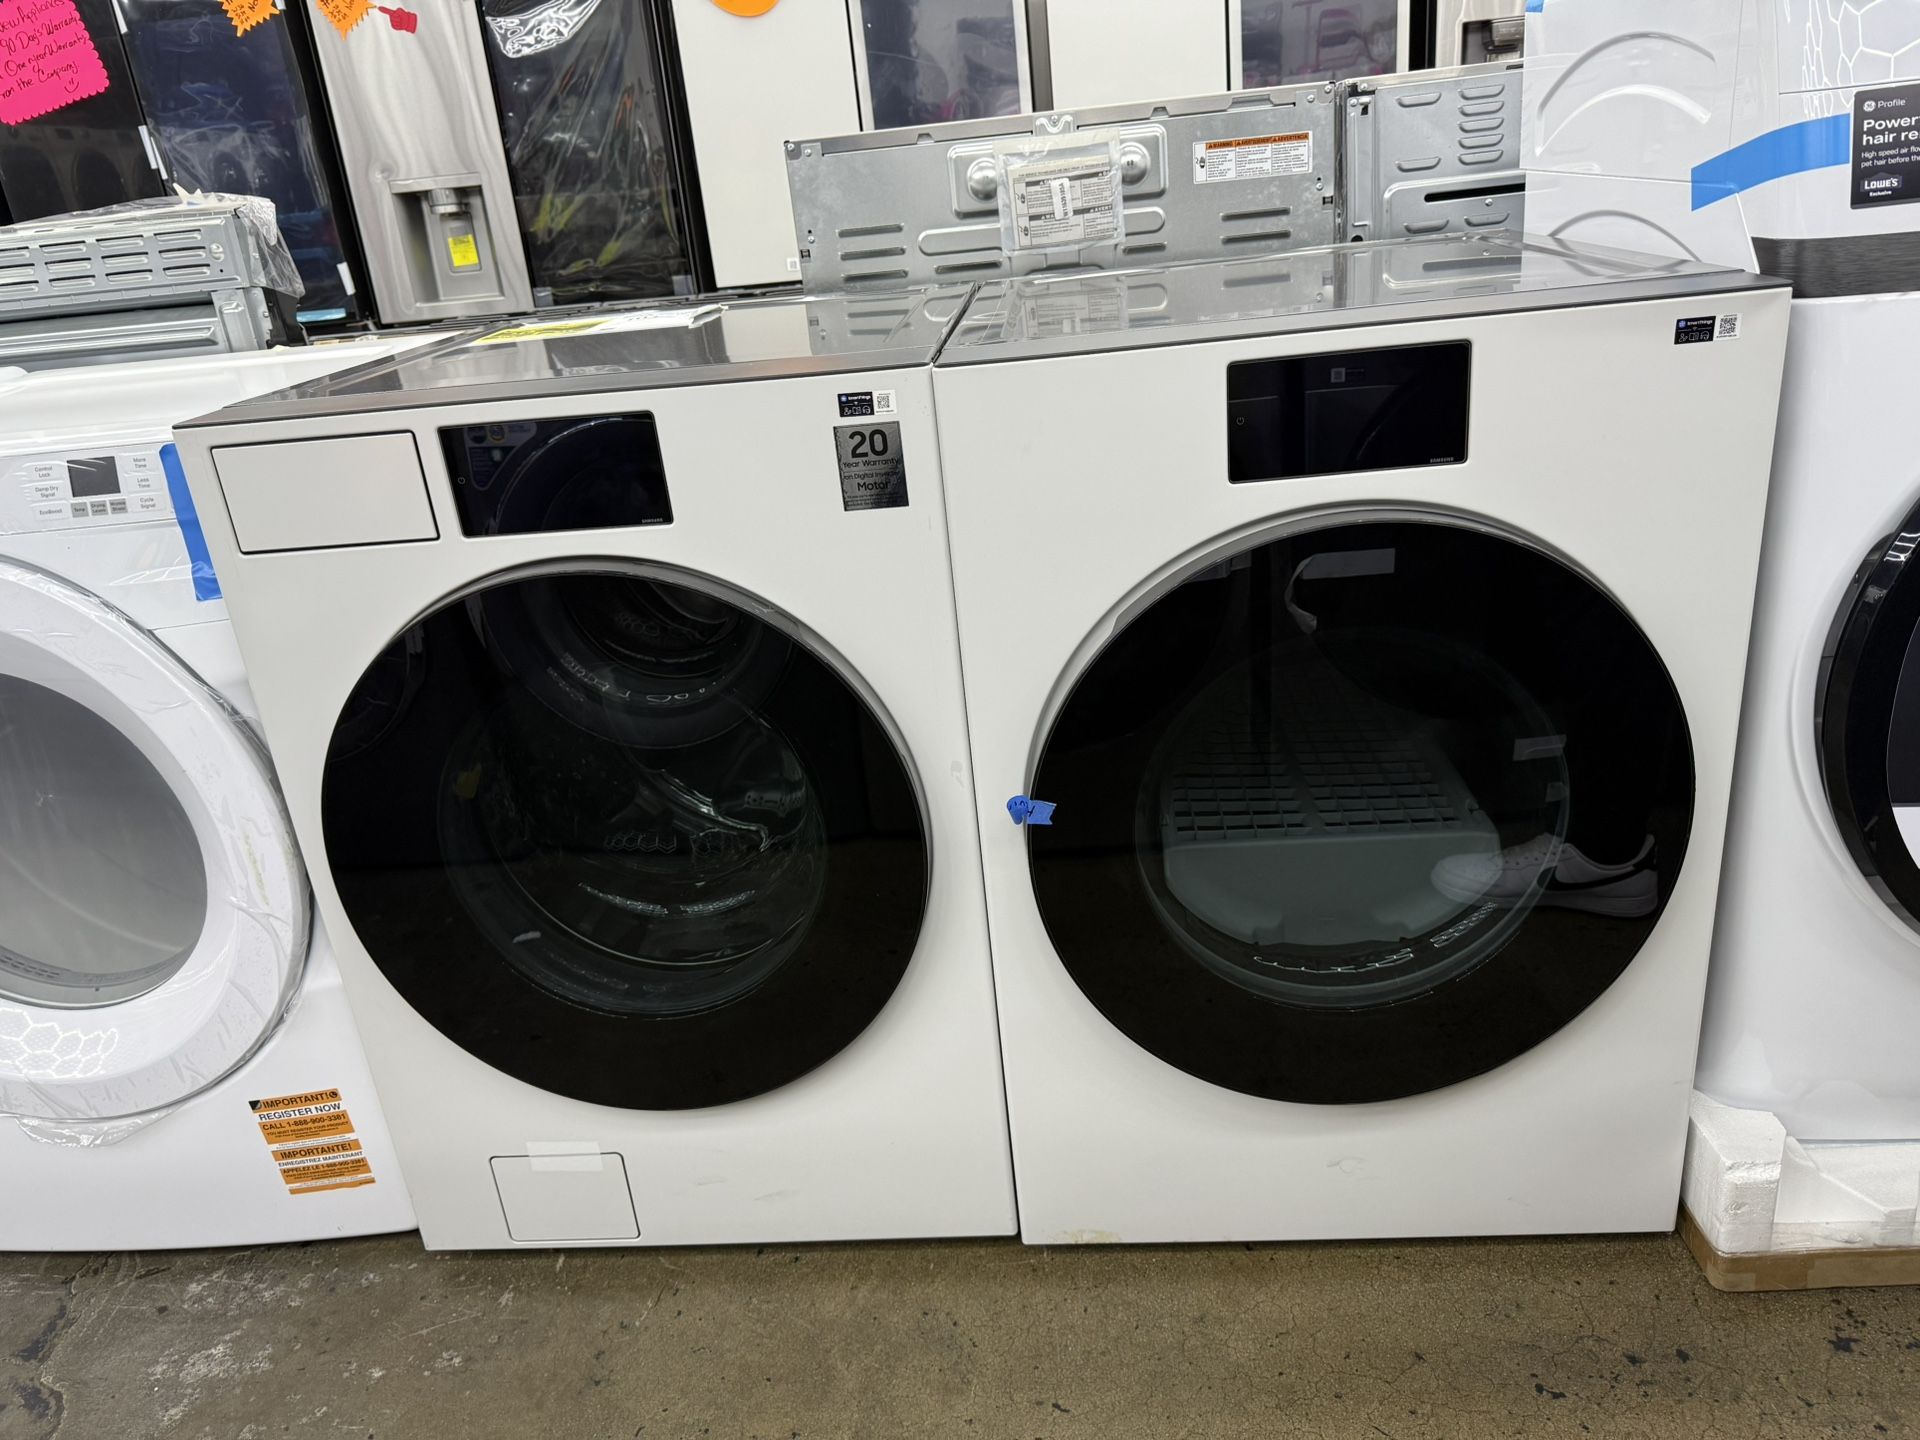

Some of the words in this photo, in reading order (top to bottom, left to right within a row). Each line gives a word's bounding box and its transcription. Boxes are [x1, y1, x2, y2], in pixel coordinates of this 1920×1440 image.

[4, 60, 26, 77] One
[16, 78, 33, 90] the
[1878, 98, 1906, 108] Profile
[1864, 116, 1920, 132] Power
[1862, 131, 1896, 146] hair
[1901, 130, 1920, 141] re
[1862, 150, 1877, 160] High
[1878, 147, 1898, 158] speed
[1874, 158, 1886, 166] hair
[1888, 155, 1910, 164] before
[1864, 178, 1898, 190] LOWE'S
[848, 429, 888, 458] 20
[862, 458, 898, 467] Warranty
[854, 472, 874, 480] Digital
[857, 481, 890, 491] Motor
[262, 1092, 329, 1109] IMPORTANT!
[258, 1107, 313, 1121] REGISTER
[315, 1103, 341, 1114] NOW
[263, 1121, 285, 1131] CALL
[280, 1143, 352, 1160] IMPORTANTE!
[278, 1157, 321, 1167] ENREGISTREZ
[323, 1151, 363, 1162] MAINTENANT
